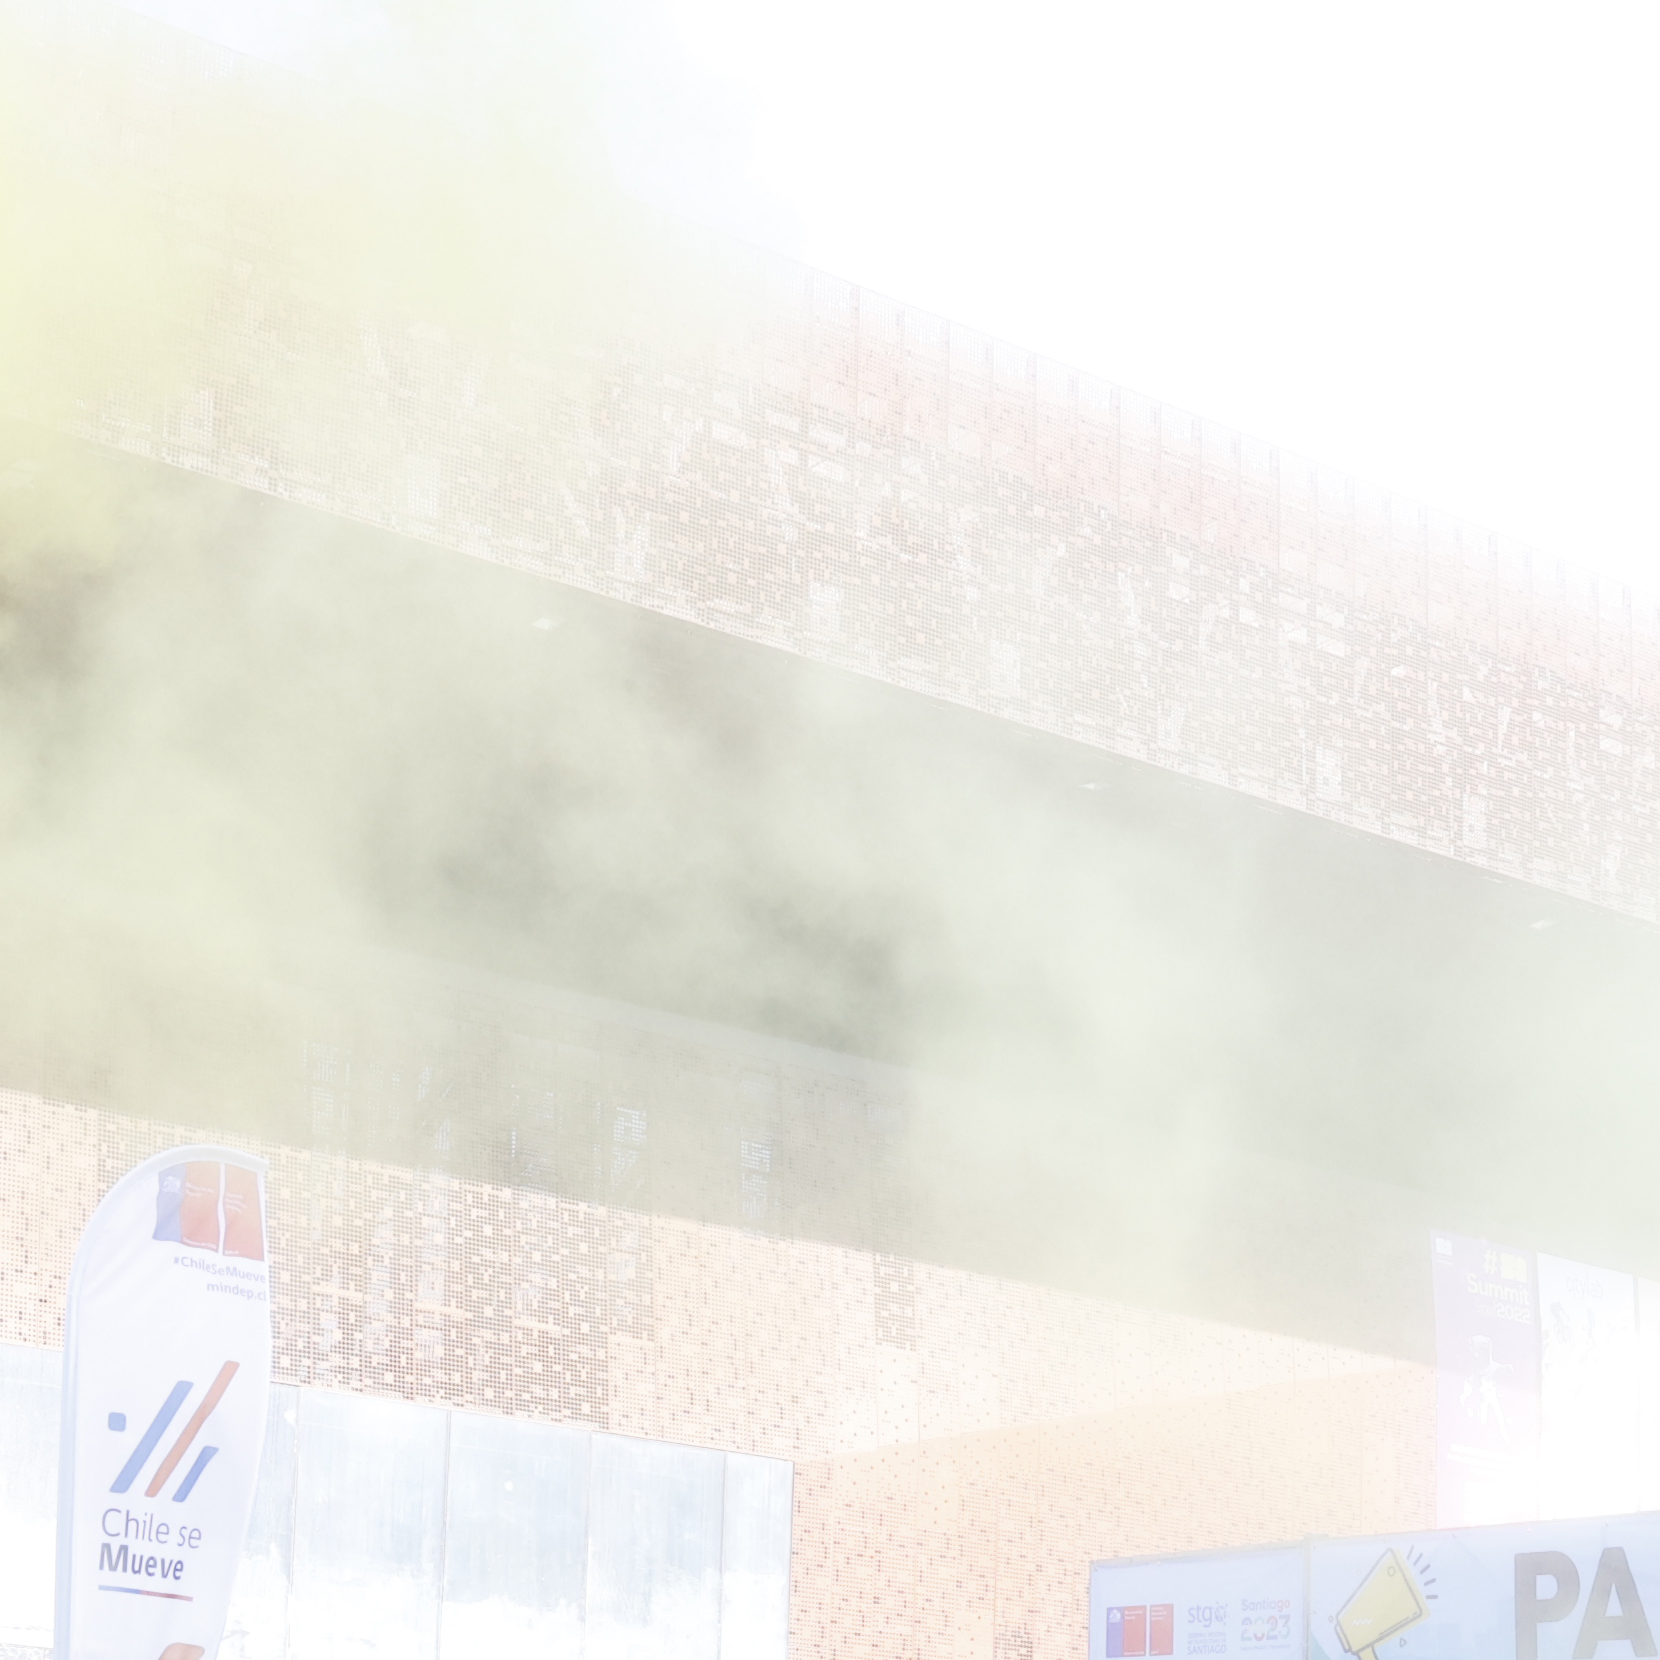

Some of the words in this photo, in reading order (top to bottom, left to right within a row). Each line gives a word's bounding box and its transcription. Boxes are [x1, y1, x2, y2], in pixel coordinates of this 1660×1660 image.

[173, 1256, 266, 1283] #ChileSeMueve
[206, 1281, 267, 1302] mindep.cl
[1466, 1272, 1531, 1305] Summit
[102, 1508, 170, 1544] Chile
[176, 1526, 202, 1549] se
[99, 1542, 185, 1581] Mueve
[1241, 1598, 1291, 1613] Santiago
[1240, 1614, 1291, 1642] 2023
[1187, 1645, 1227, 1656] SANTIAGO
